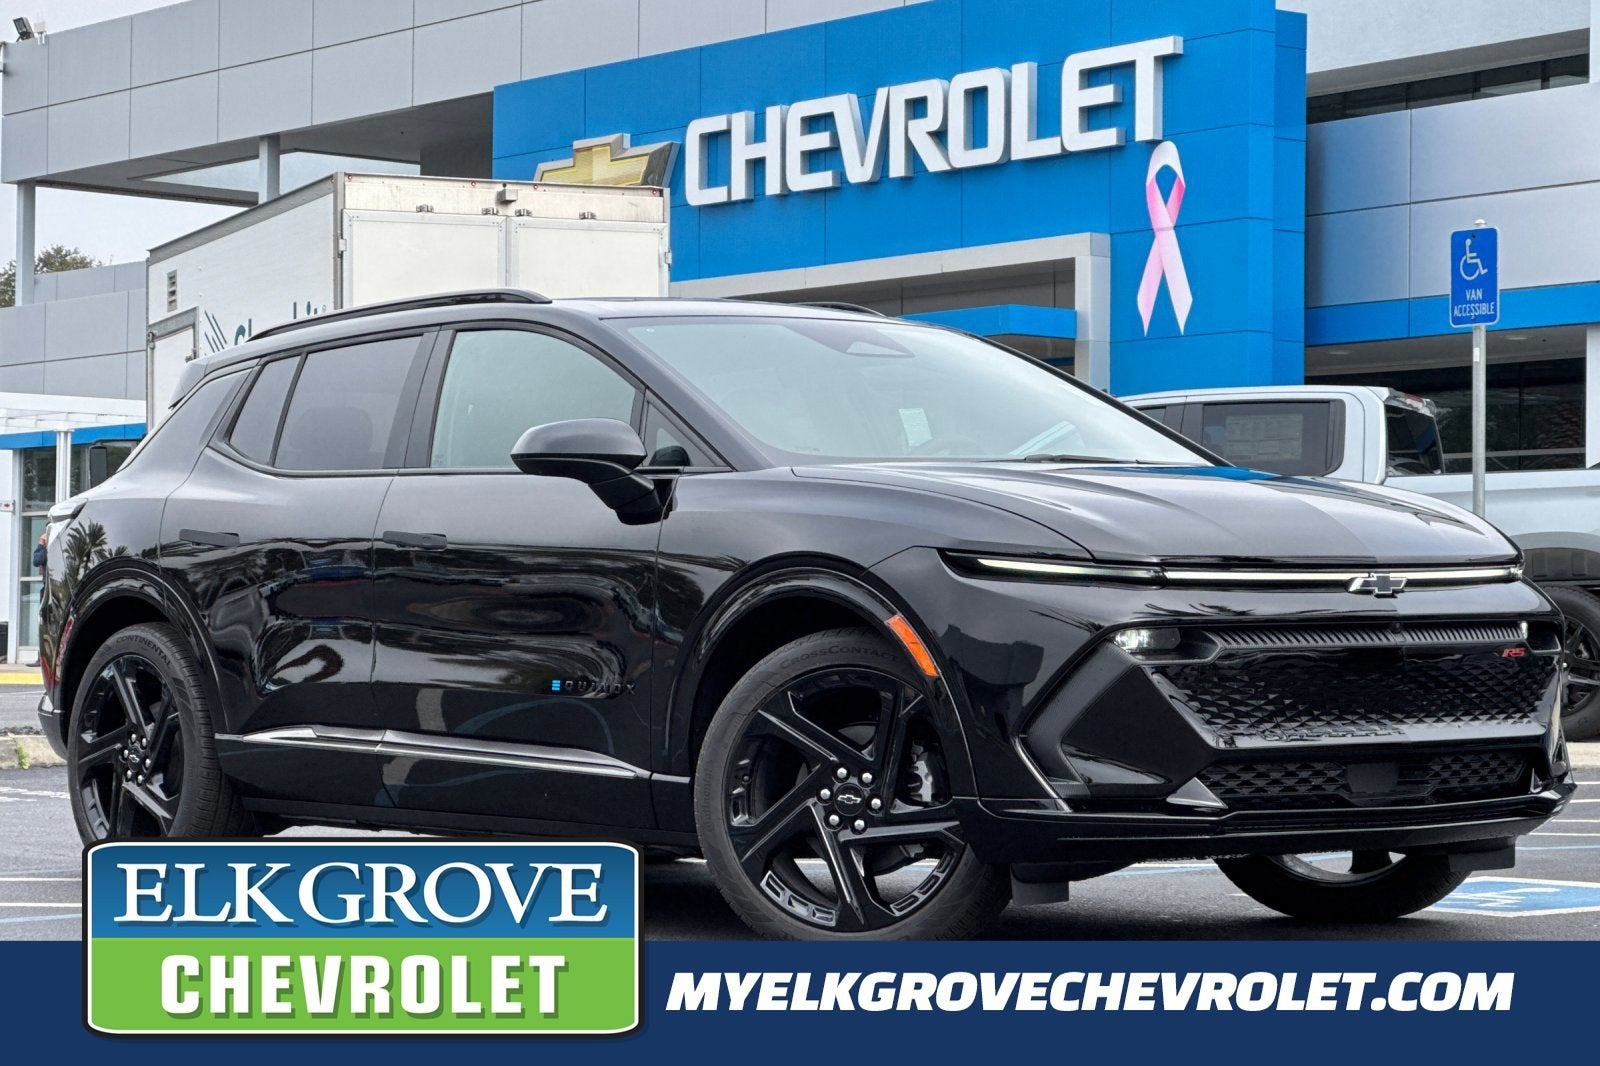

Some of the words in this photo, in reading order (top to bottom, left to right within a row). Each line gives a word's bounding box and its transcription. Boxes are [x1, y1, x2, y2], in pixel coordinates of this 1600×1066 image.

[685, 35, 1185, 206] CHEVROLET
[1465, 287, 1483, 302] VAN
[1453, 302, 1496, 318] ACCESSIBLE
[1502, 647, 1526, 658] RS
